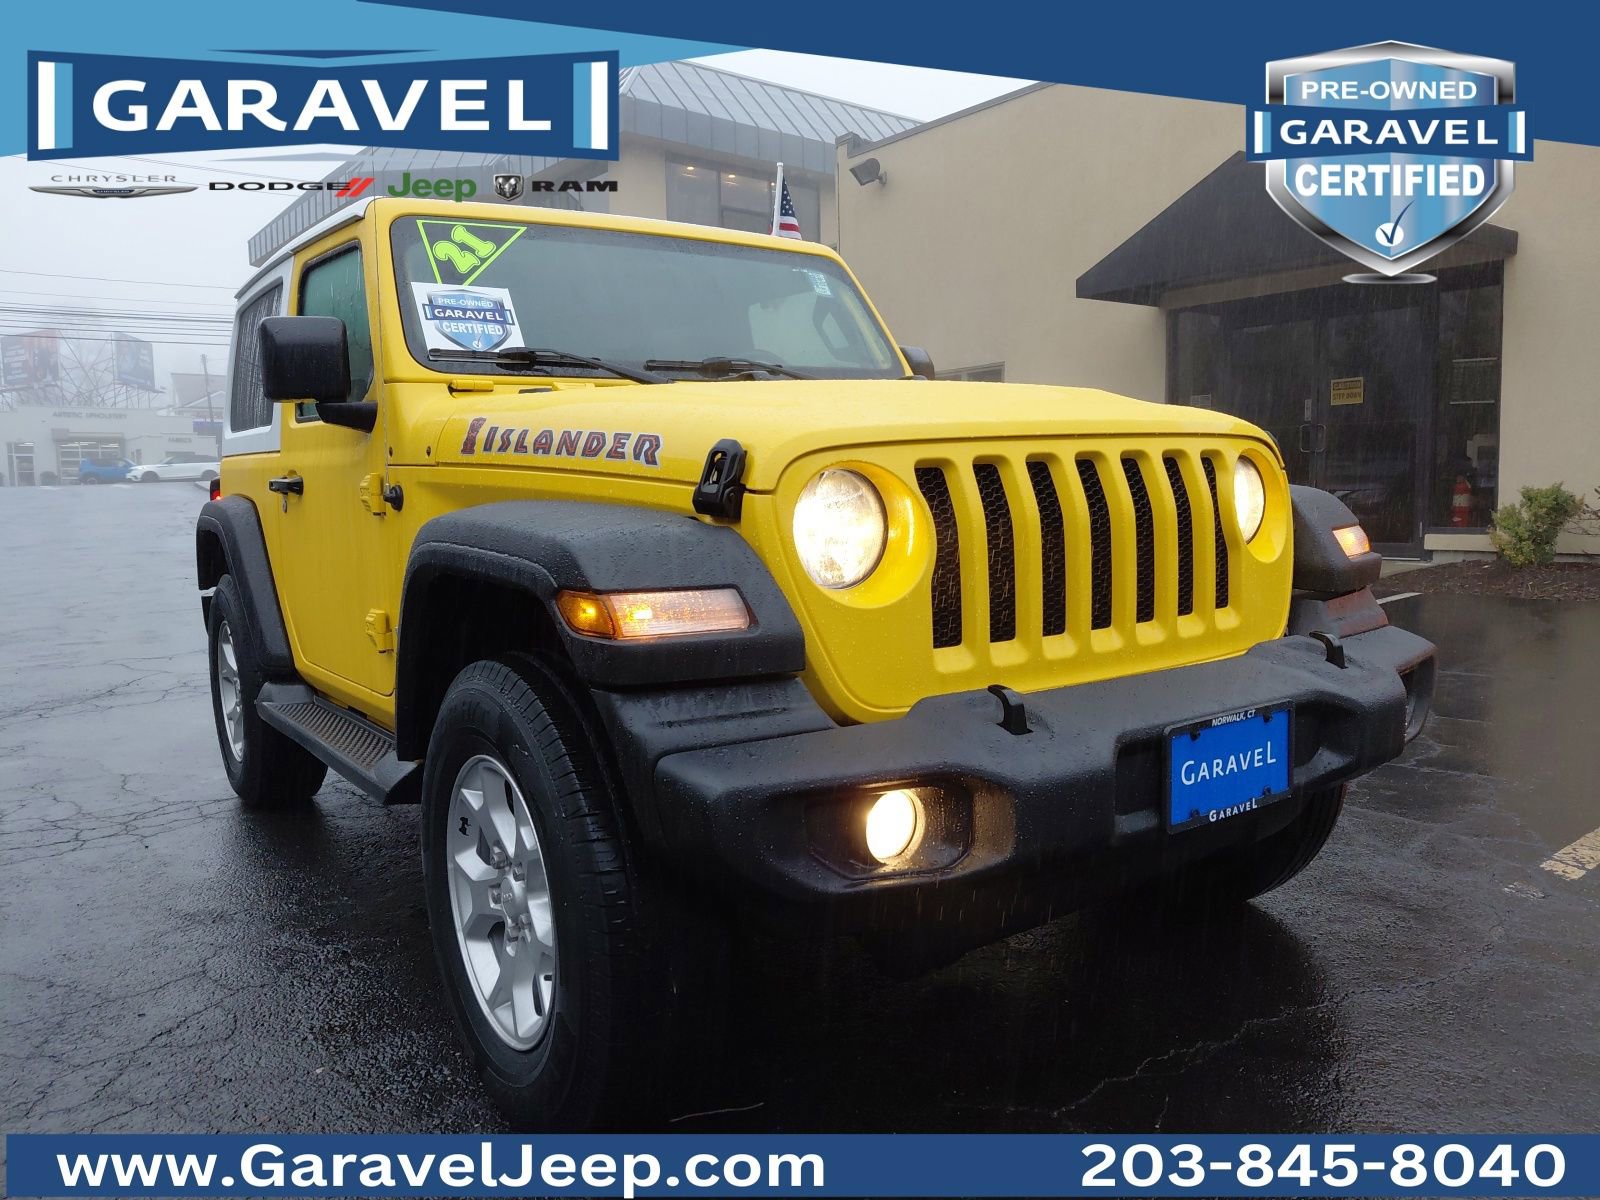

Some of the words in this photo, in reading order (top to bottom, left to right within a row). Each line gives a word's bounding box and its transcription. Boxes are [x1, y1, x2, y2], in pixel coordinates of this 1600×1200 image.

[432, 224, 497, 274] 21
[437, 297, 494, 308] PRE-OWNED
[434, 308, 504, 321] GARAVEL
[442, 322, 504, 335] CERTIFIED
[483, 426, 661, 467] ISLANDER
[1211, 713, 1246, 727] NORWALK,
[1247, 709, 1256, 719] CT
[1181, 740, 1277, 786] GARAVEL
[1209, 798, 1258, 822] GARAVEL
